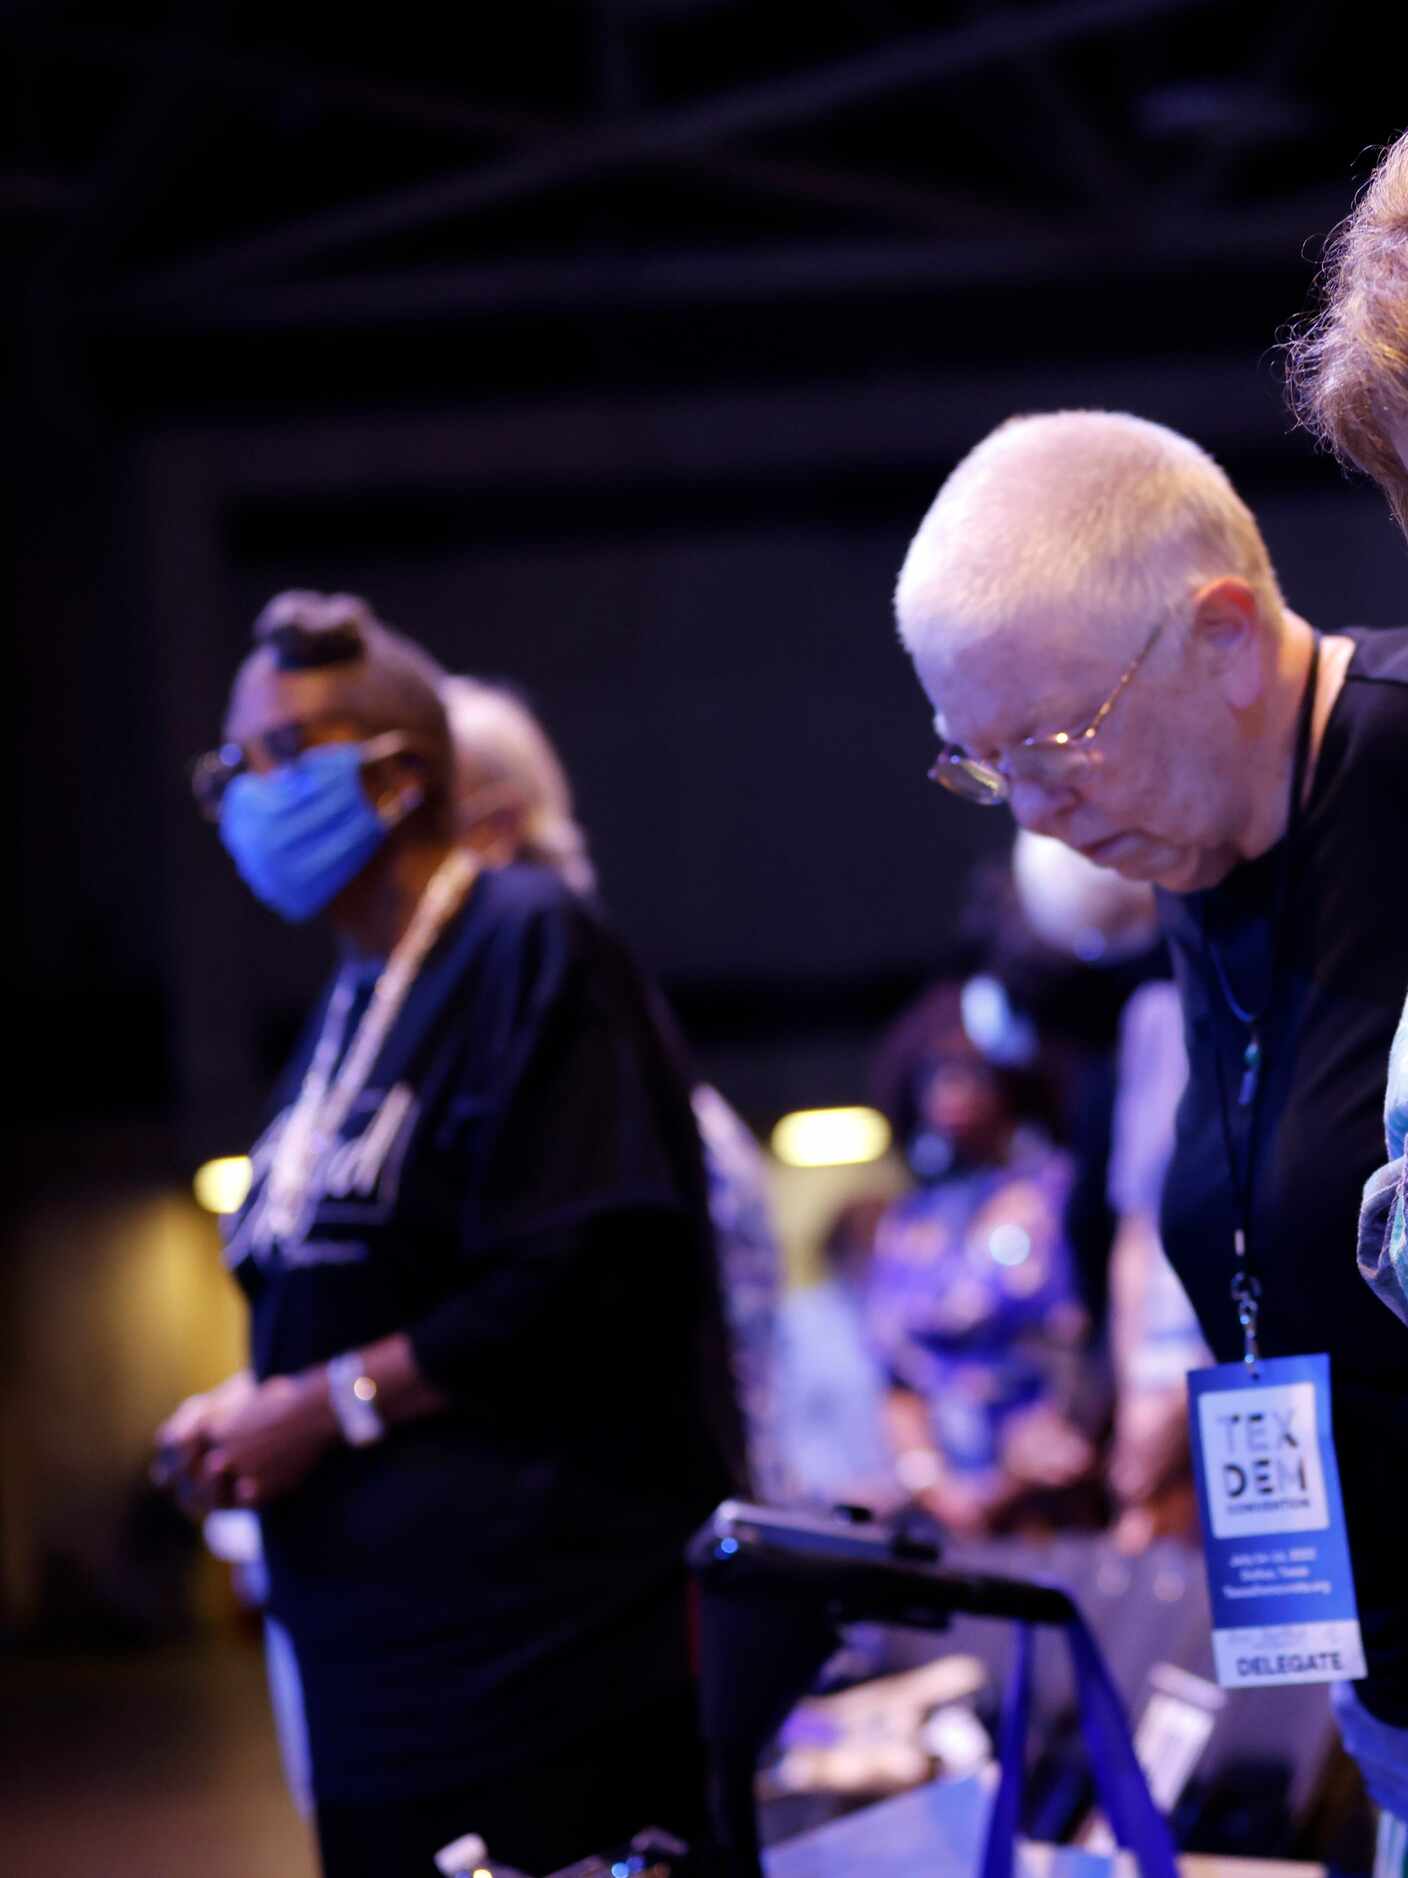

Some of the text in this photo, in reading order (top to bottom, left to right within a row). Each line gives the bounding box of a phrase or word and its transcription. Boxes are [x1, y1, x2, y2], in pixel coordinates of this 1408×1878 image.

[1216, 1411, 1298, 1452] TEX
[1222, 1456, 1308, 1498] DEM
[1236, 1652, 1342, 1677] DELEGATE
